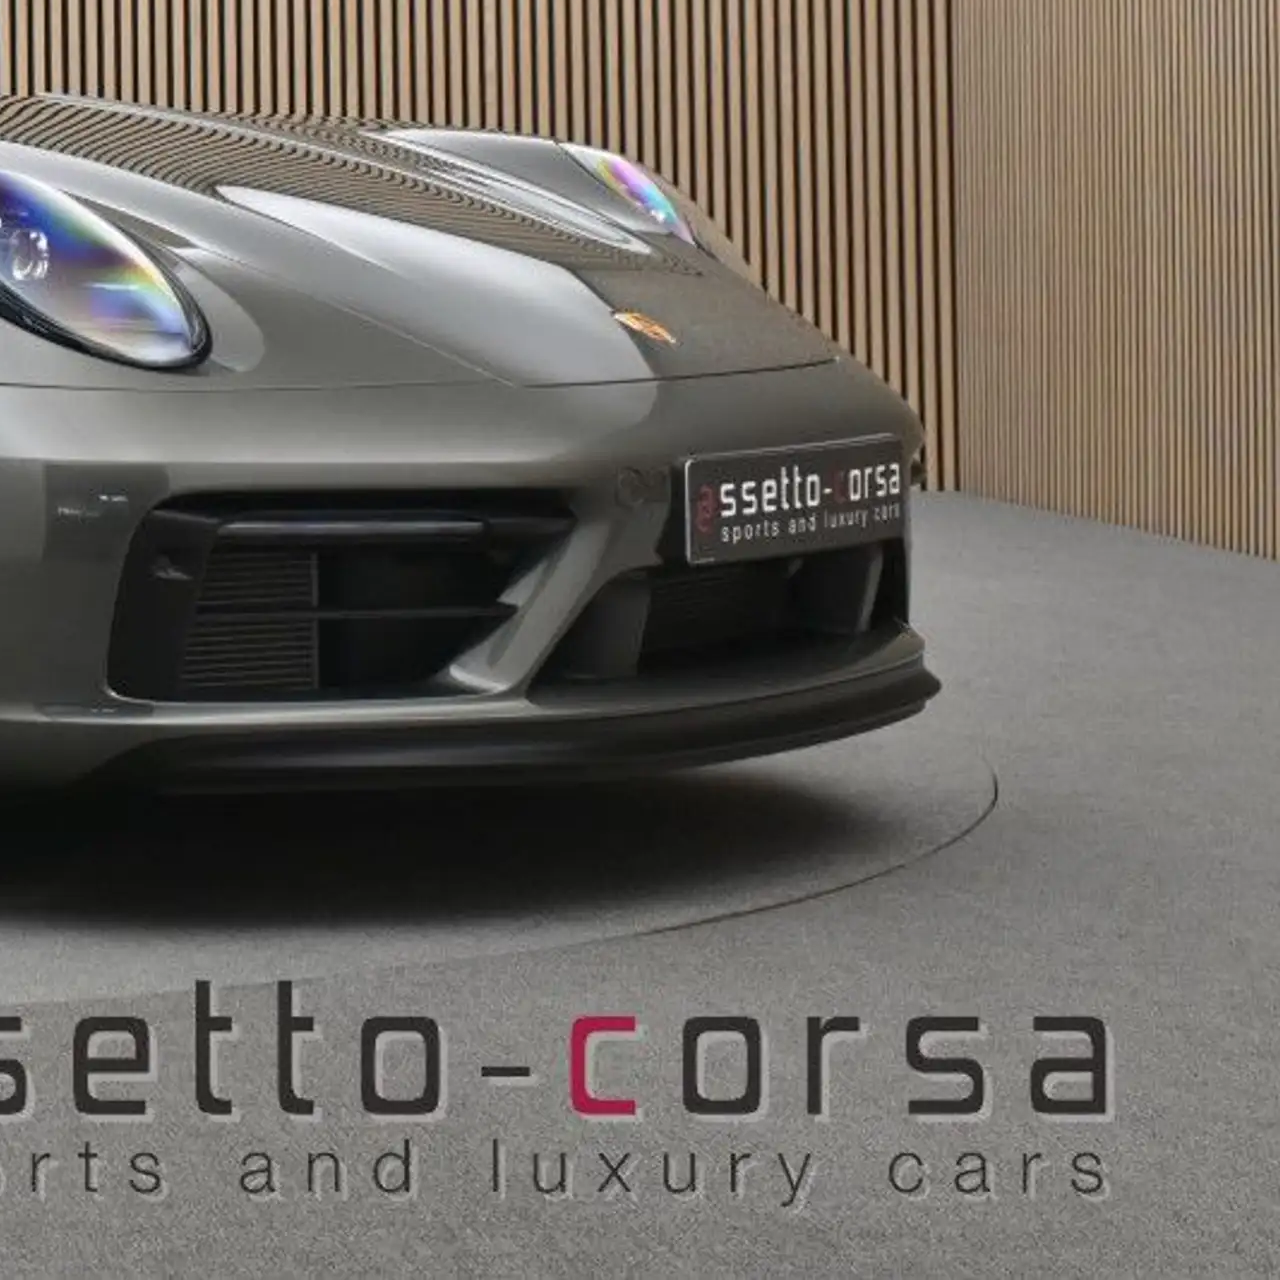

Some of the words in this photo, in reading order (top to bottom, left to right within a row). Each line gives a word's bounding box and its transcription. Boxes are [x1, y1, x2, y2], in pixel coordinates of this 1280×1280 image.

[721, 519, 780, 544] sports
[788, 515, 817, 535] and
[824, 508, 868, 529] luxury
